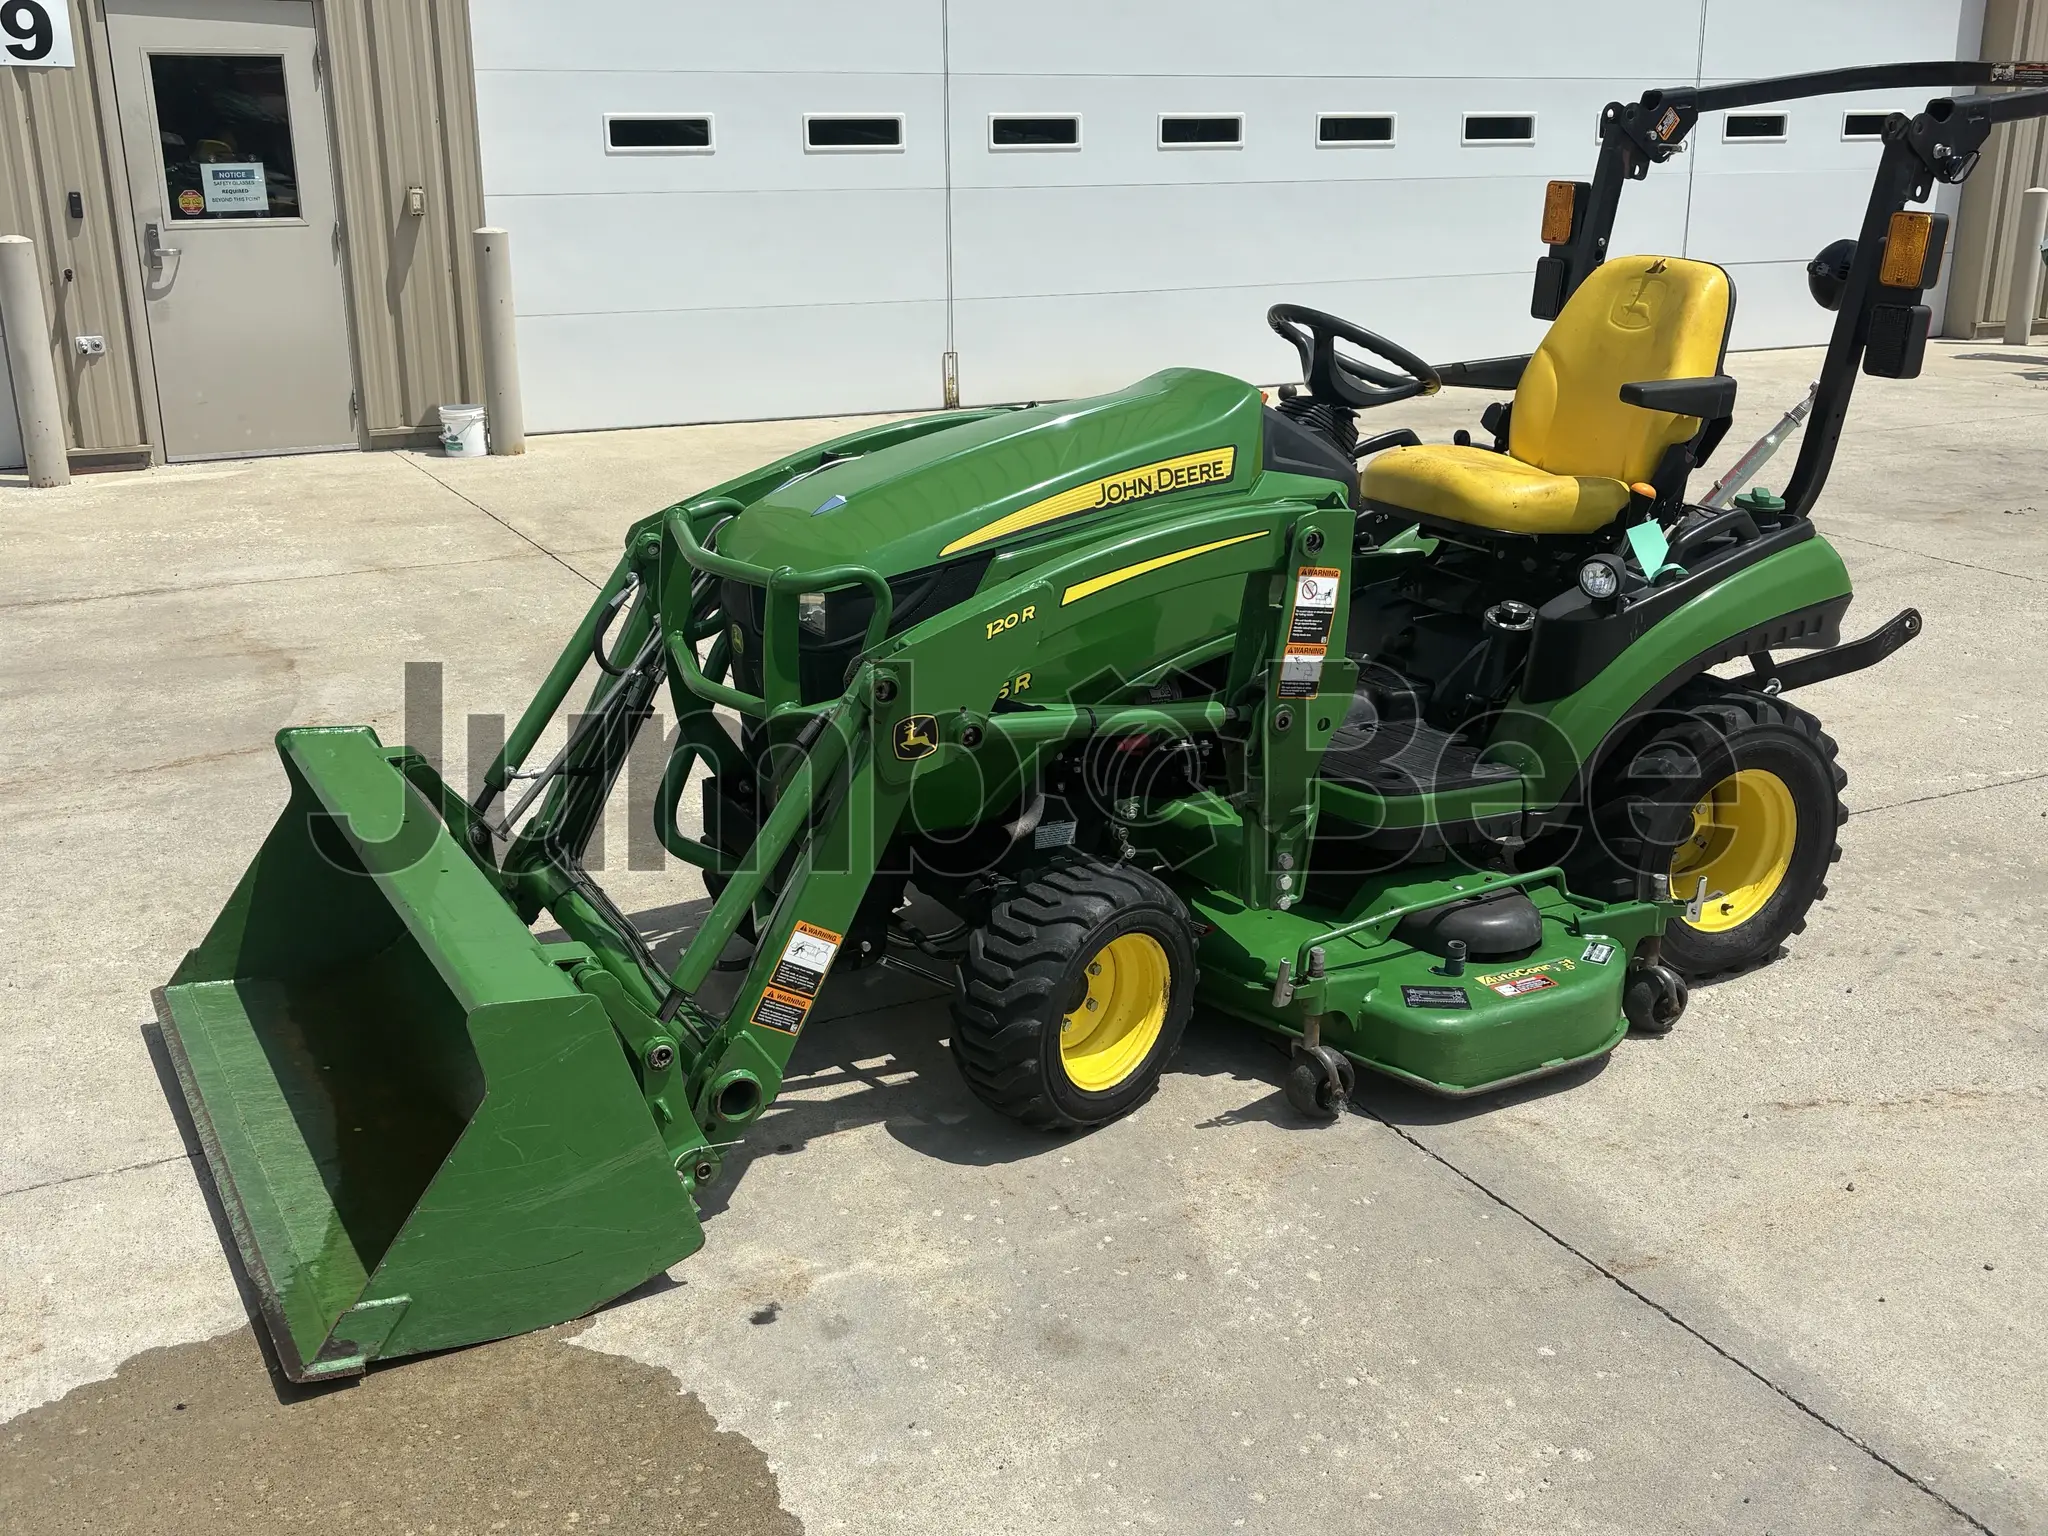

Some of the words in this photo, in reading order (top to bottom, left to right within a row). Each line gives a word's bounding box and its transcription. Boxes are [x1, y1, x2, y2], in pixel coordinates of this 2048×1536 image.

[0, 0, 53, 60] 9
[219, 171, 246, 179] NOTICE
[1095, 476, 1152, 506] JOHN
[1158, 460, 1225, 490] DEERE
[1306, 569, 1339, 578] WARNING
[1293, 646, 1325, 655] WARNING
[808, 928, 837, 942] WARNING
[776, 991, 806, 1008] WARNING
